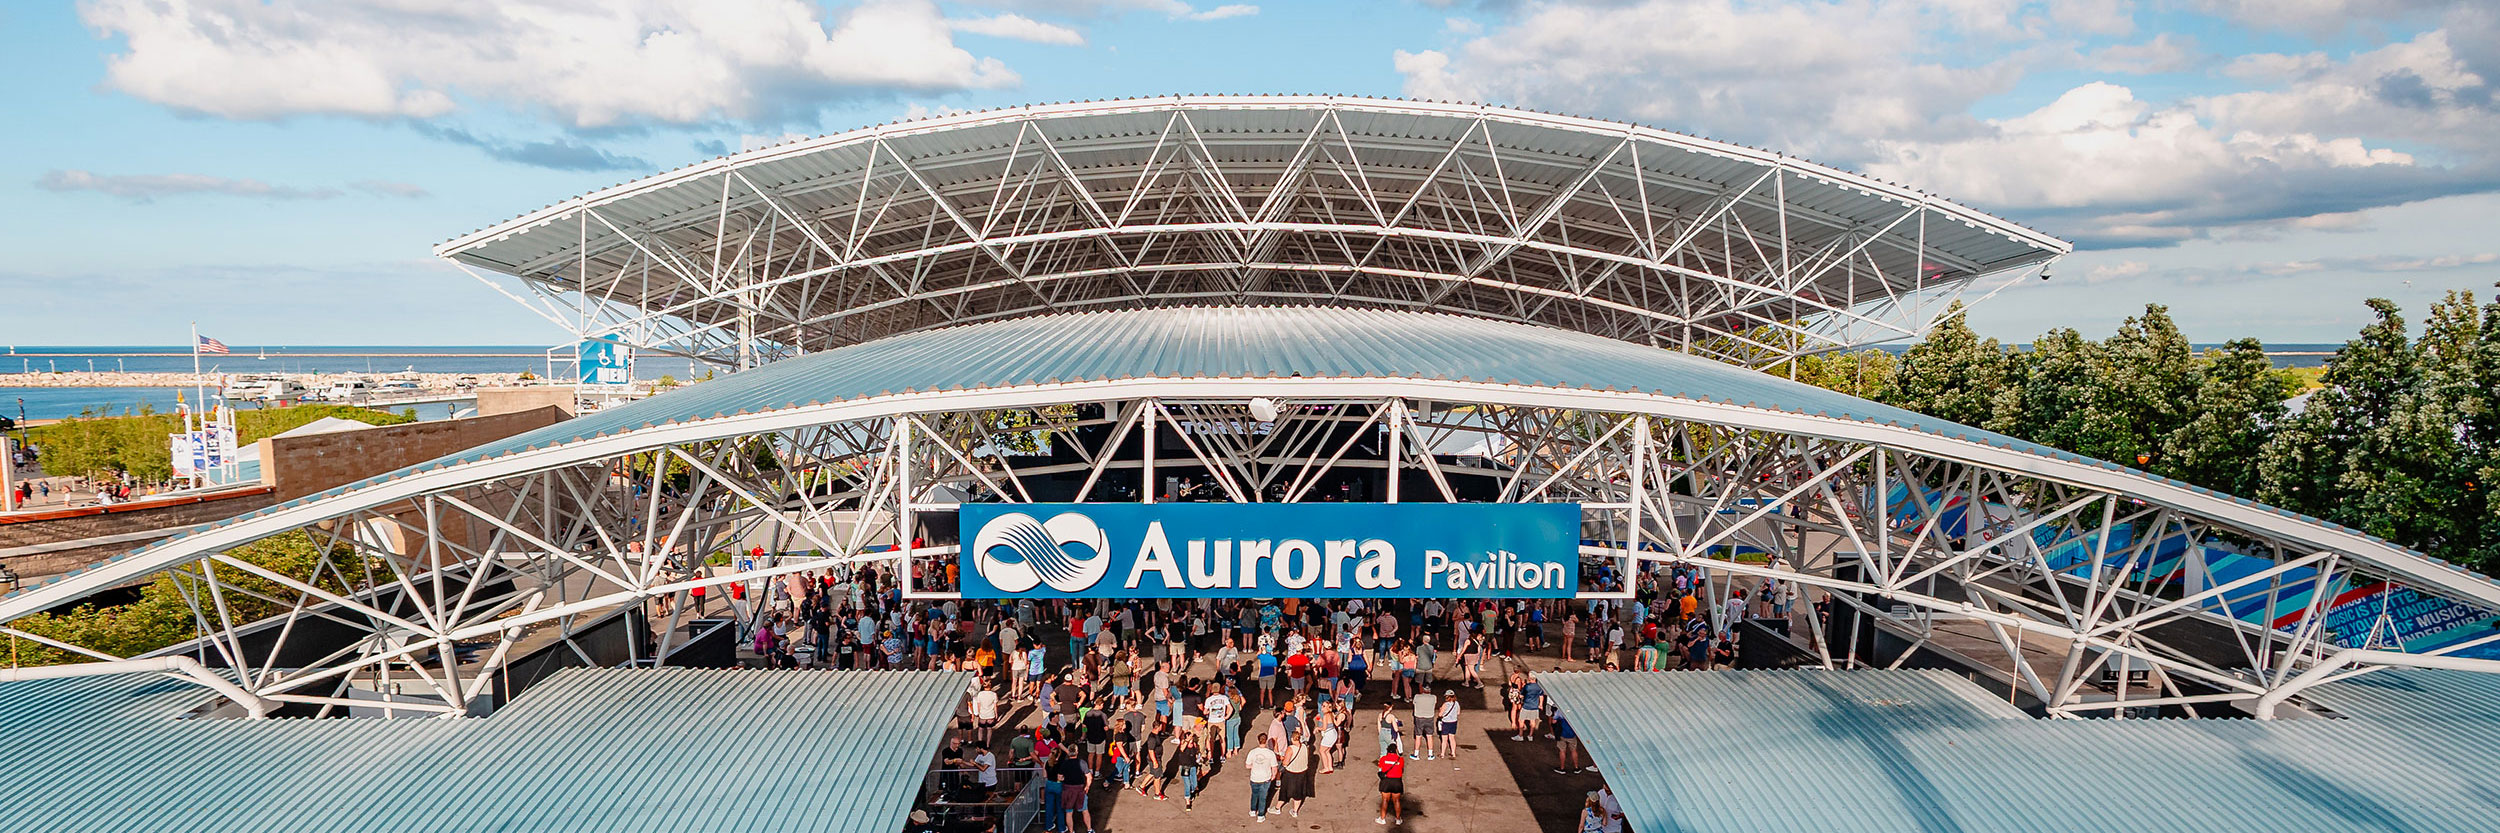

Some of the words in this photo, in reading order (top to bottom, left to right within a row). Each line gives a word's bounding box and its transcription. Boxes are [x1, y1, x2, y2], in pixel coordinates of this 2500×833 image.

[1124, 521, 1401, 590] Aurora
[1424, 549, 1566, 590] Pavilion
[2327, 608, 2355, 628] MUSIC
[2355, 604, 2370, 618] IS
[2415, 604, 2466, 628] MUSIC
